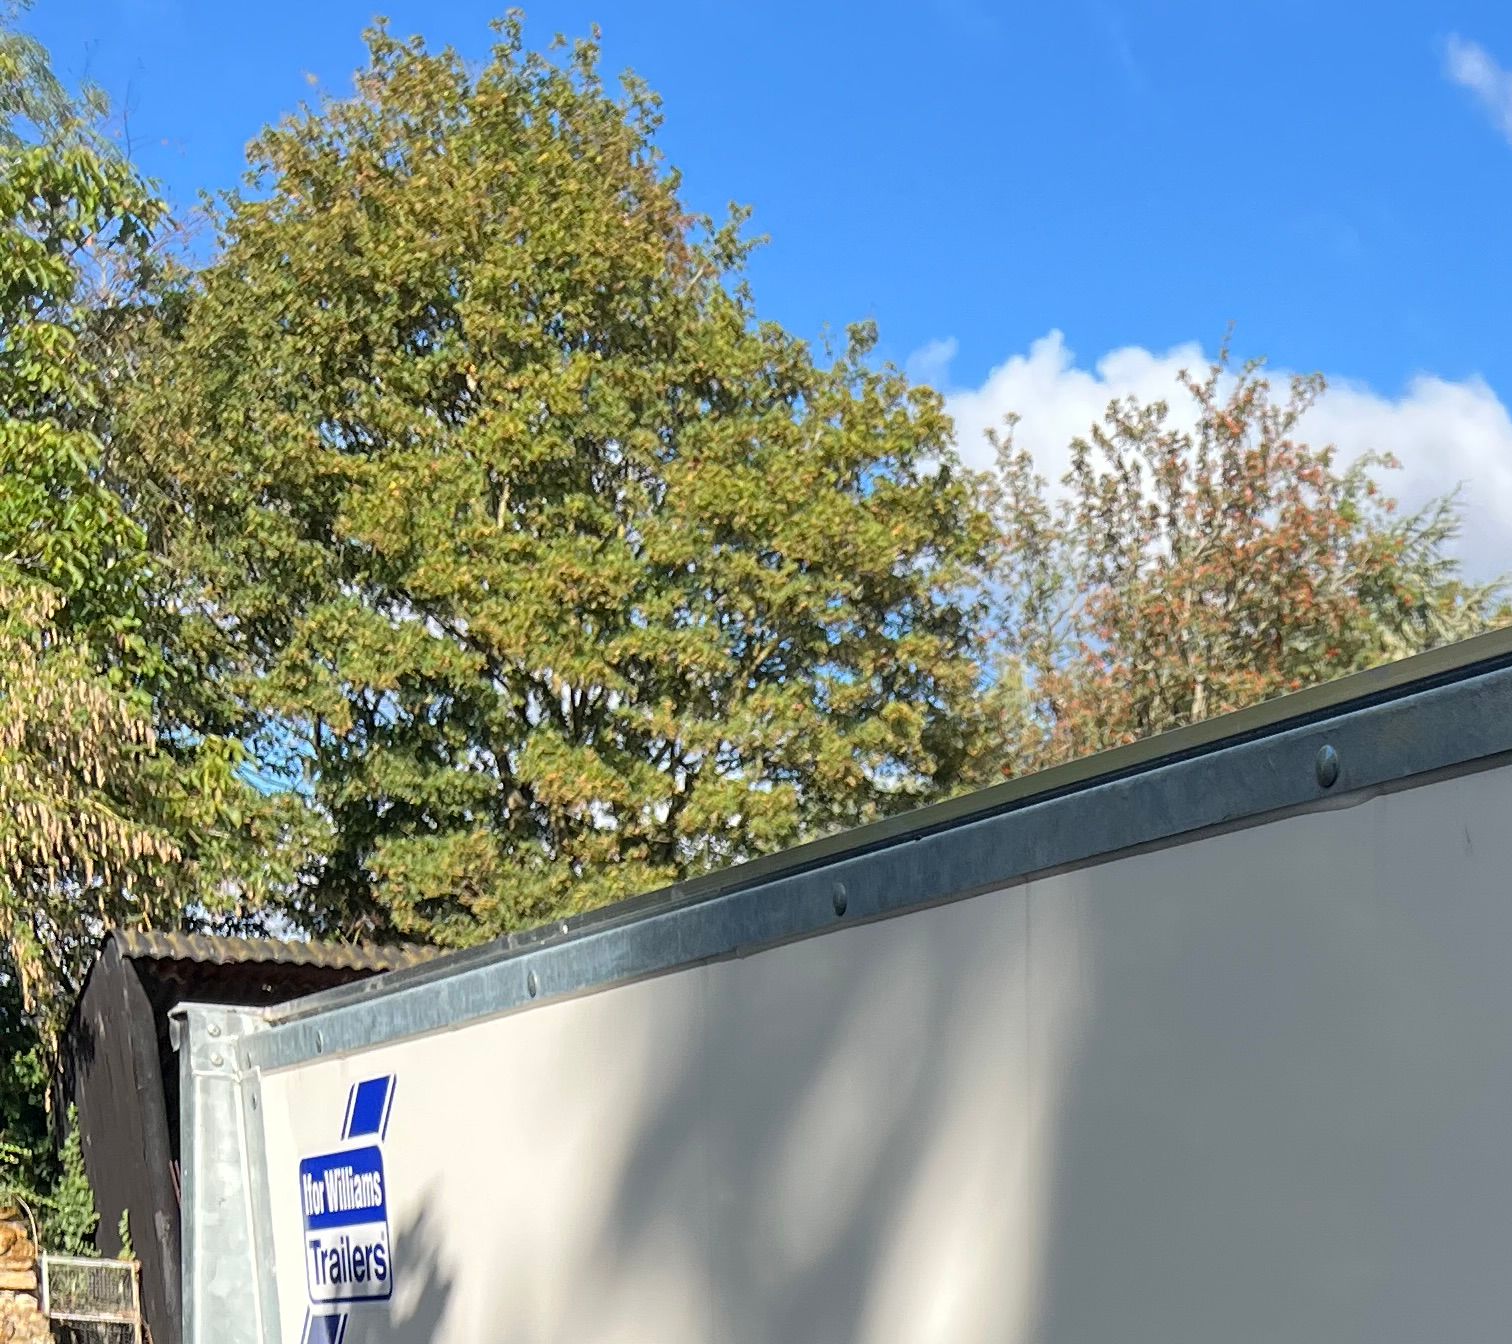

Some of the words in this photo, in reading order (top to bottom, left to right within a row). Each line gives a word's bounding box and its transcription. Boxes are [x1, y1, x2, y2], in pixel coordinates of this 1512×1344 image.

[303, 1173, 324, 1215] Ifor
[325, 1167, 382, 1211] Williams
[310, 1236, 387, 1285] Trailers
